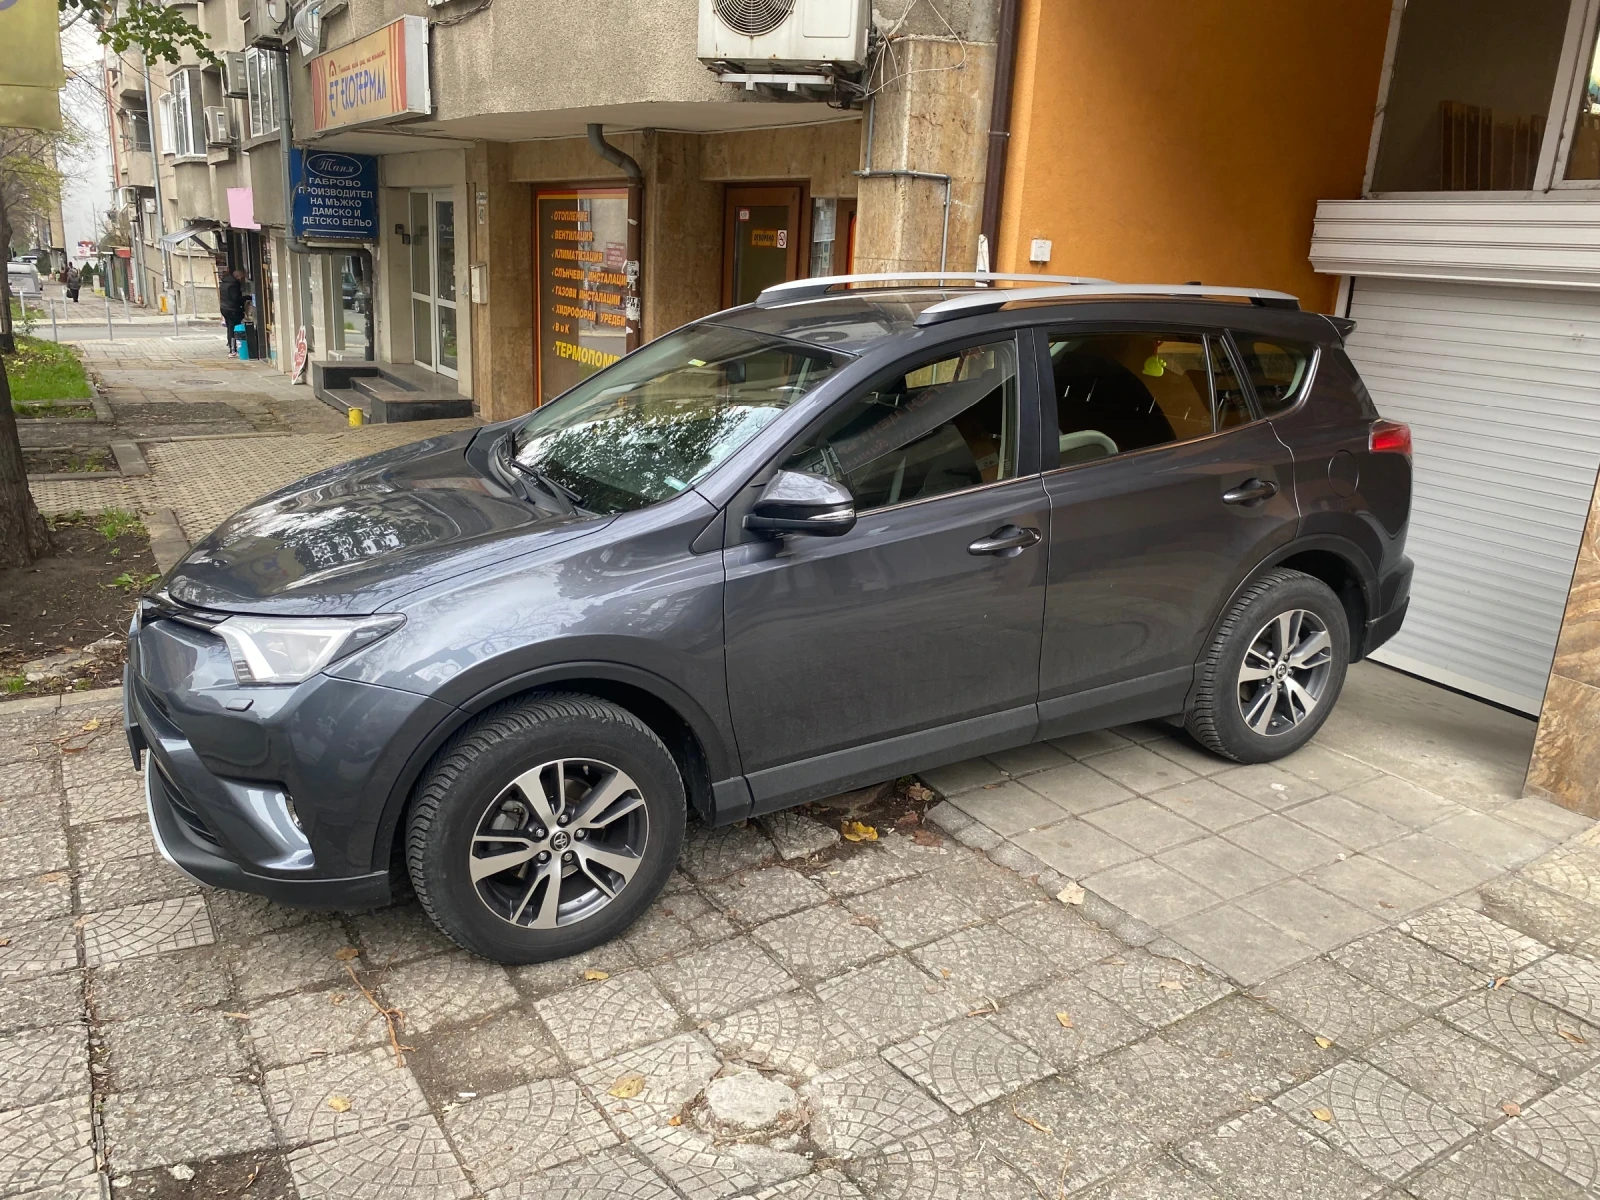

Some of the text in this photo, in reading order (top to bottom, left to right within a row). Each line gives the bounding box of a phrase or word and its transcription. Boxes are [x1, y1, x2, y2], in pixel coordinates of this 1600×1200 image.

[317, 158, 354, 173] Таня
[309, 177, 361, 187] ГАБРОВО
[310, 197, 362, 207] НА МЪЖКО
[312, 207, 361, 217] ДАМСКО И
[553, 210, 589, 222] ОТОПЛЕНИЕ
[302, 216, 373, 227] ДЕТСКО БЕЛЬО
[554, 229, 593, 242] ВЕНТИЛАЦИЯ
[554, 248, 603, 262] КЛИМАТИЗАЦИЯ
[554, 267, 627, 287] СЛЪНЧЕВИ ИНСТАЛАЦИ
[555, 285, 577, 298] ГАЗОВИ
[579, 289, 621, 306] ИНСТАЛАЦИИ
[555, 304, 626, 327] ХИДРОФОРНИ УРЕДБИ
